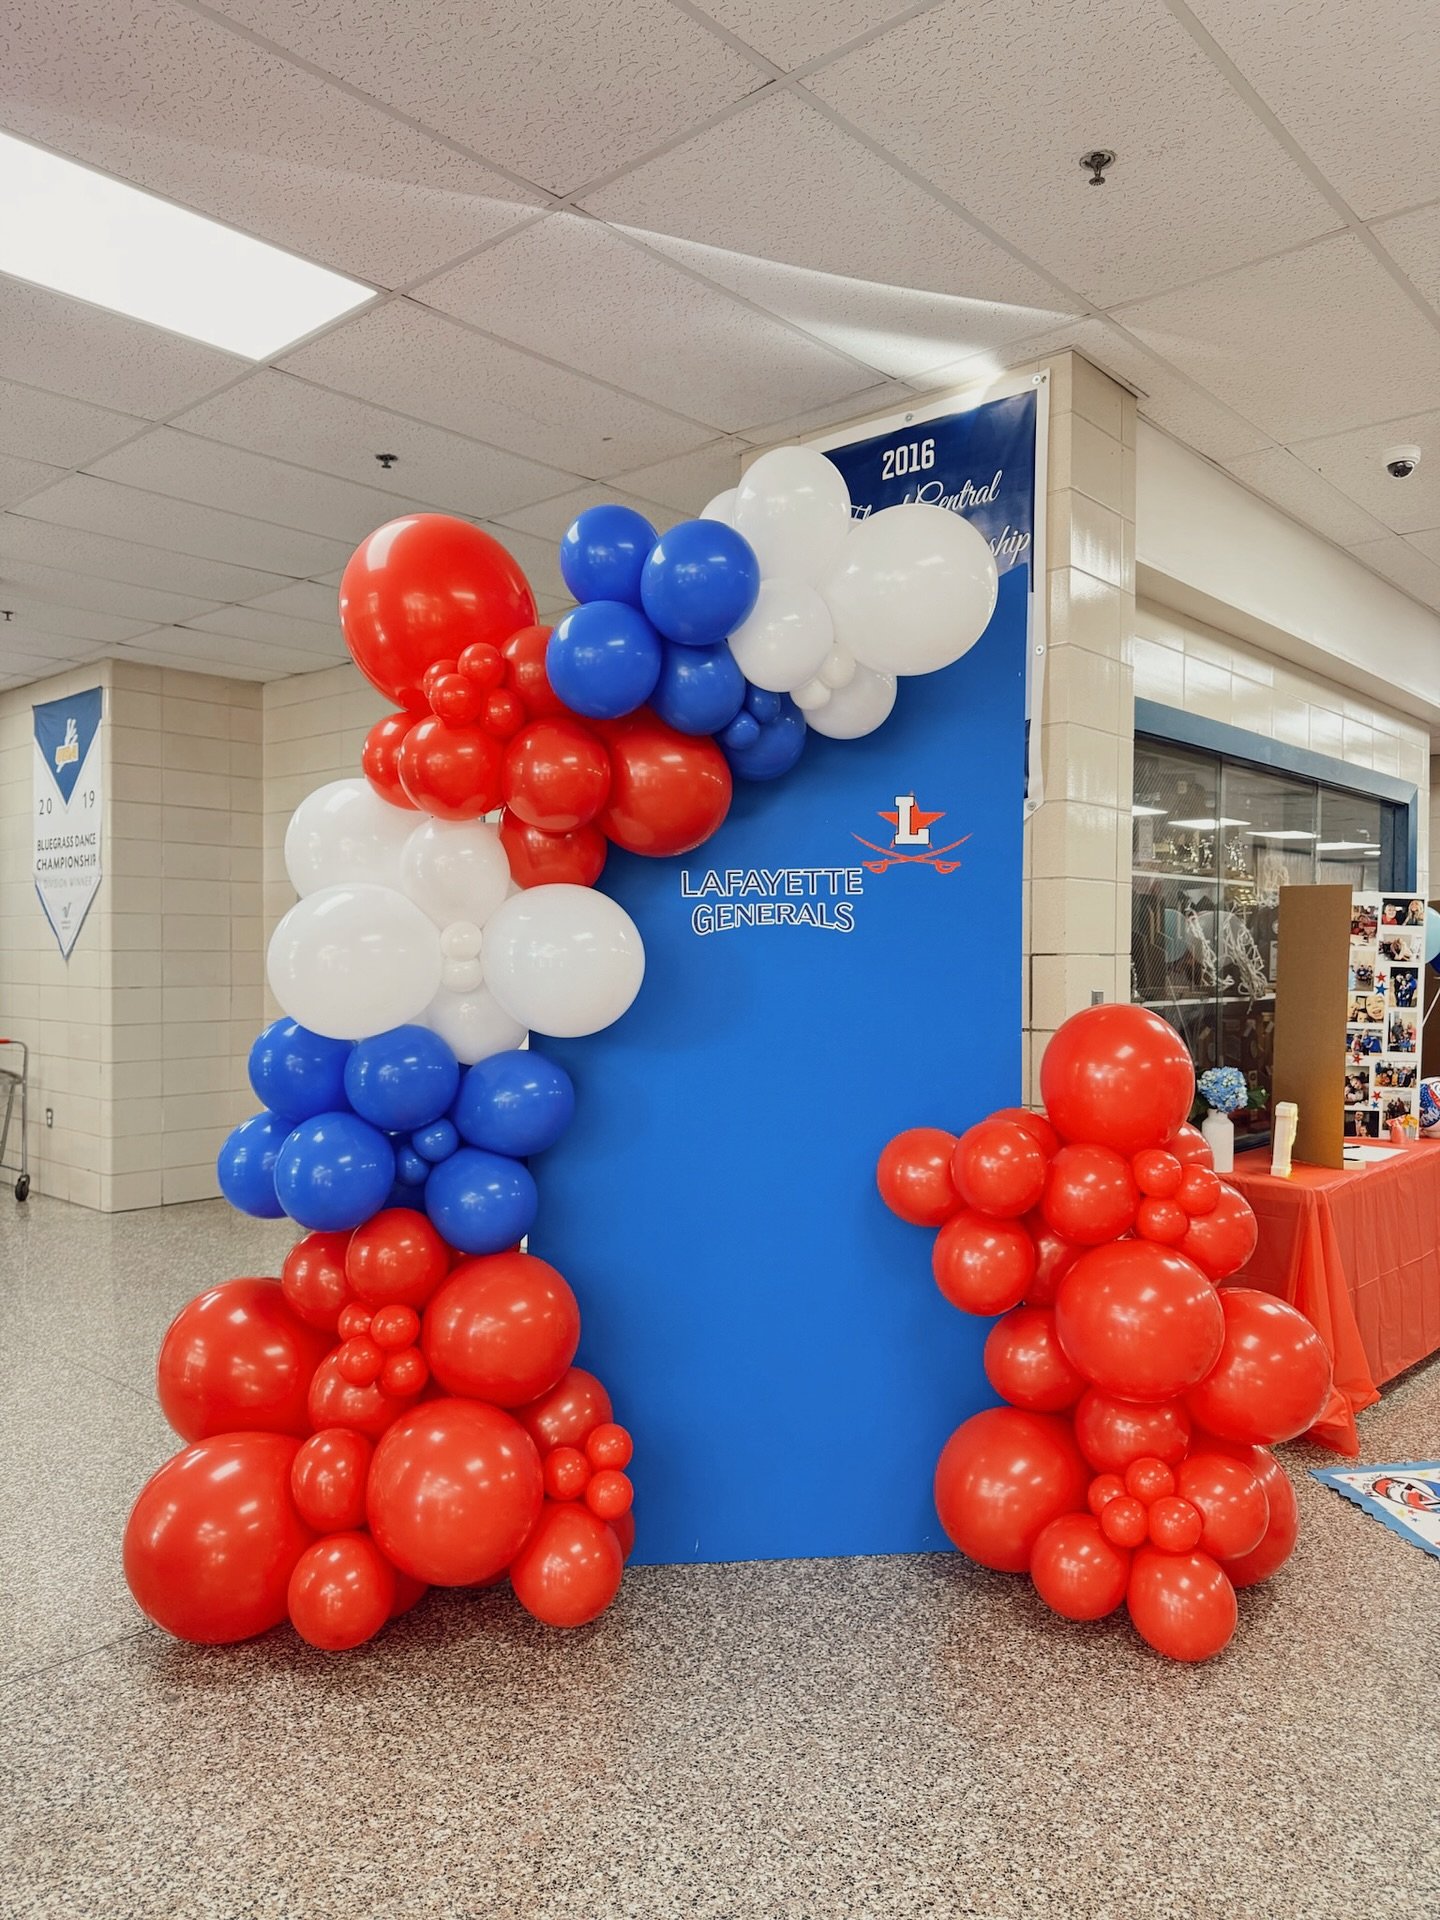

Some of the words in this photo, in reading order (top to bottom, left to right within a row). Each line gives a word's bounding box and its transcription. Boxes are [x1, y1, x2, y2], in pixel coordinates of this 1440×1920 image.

[882, 439, 935, 480] 2016
[894, 796, 930, 845] L
[37, 835, 74, 851] BLUEGRASS
[75, 833, 96, 848] DANCE
[36, 853, 97, 871] CHAMPIONSHIP
[682, 868, 863, 897] LAFAYETTE
[692, 903, 854, 935] GENERALS
